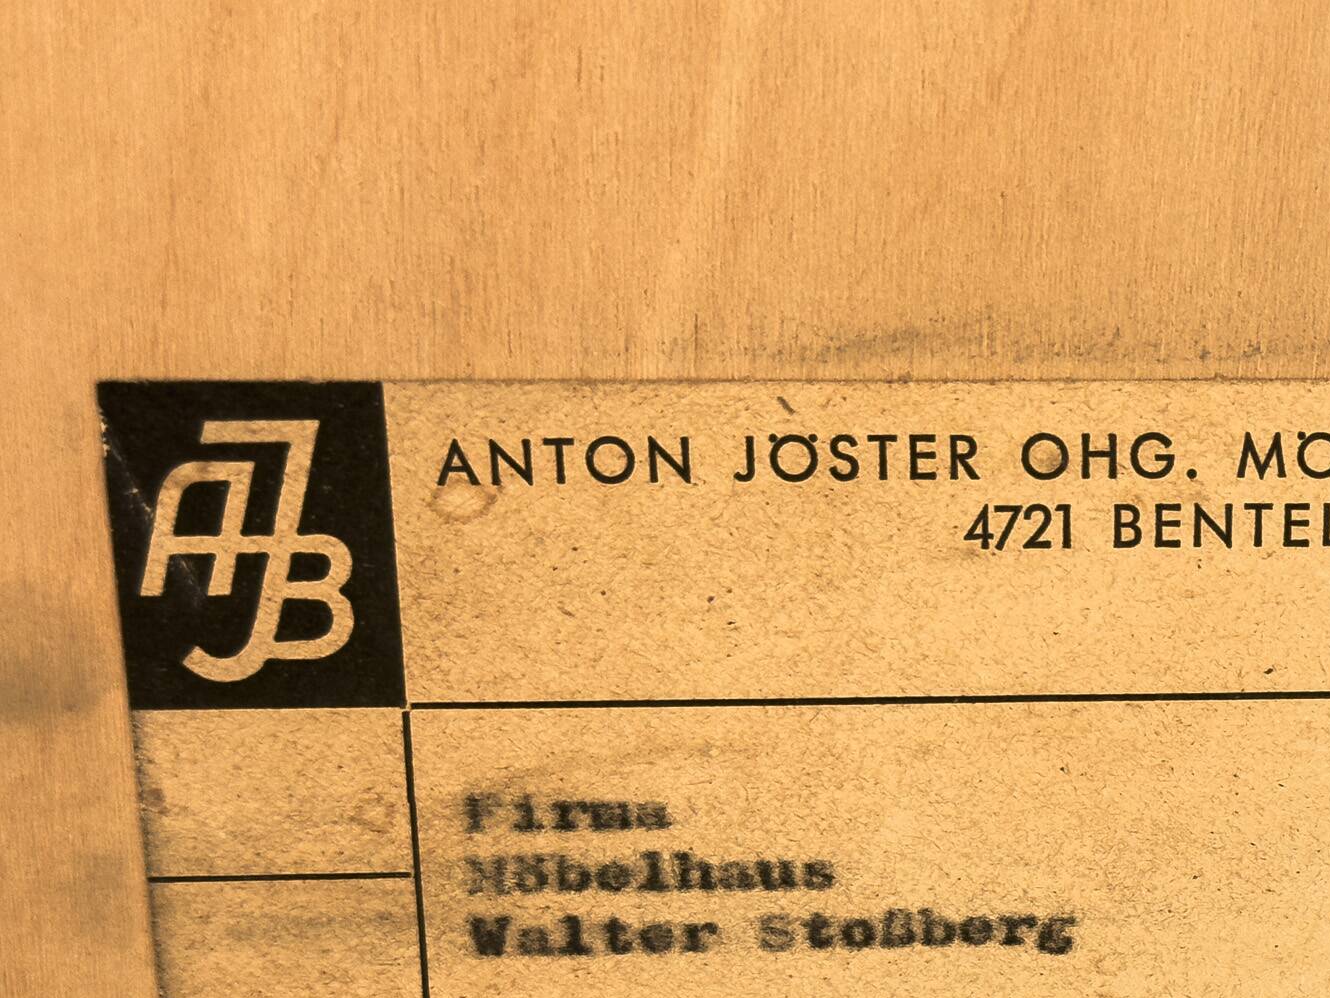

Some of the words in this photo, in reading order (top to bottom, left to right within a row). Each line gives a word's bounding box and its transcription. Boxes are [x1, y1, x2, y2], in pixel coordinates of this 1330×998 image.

[436, 434, 694, 488] ANTON
[732, 428, 982, 484] JÖSTER
[1018, 428, 1200, 482] OHG.
[960, 500, 1076, 554] 4721
[462, 790, 674, 834] Firma
[462, 850, 838, 896] Möbelhaus
[466, 912, 720, 958] Walter
[756, 908, 1078, 956] Stoßberg
